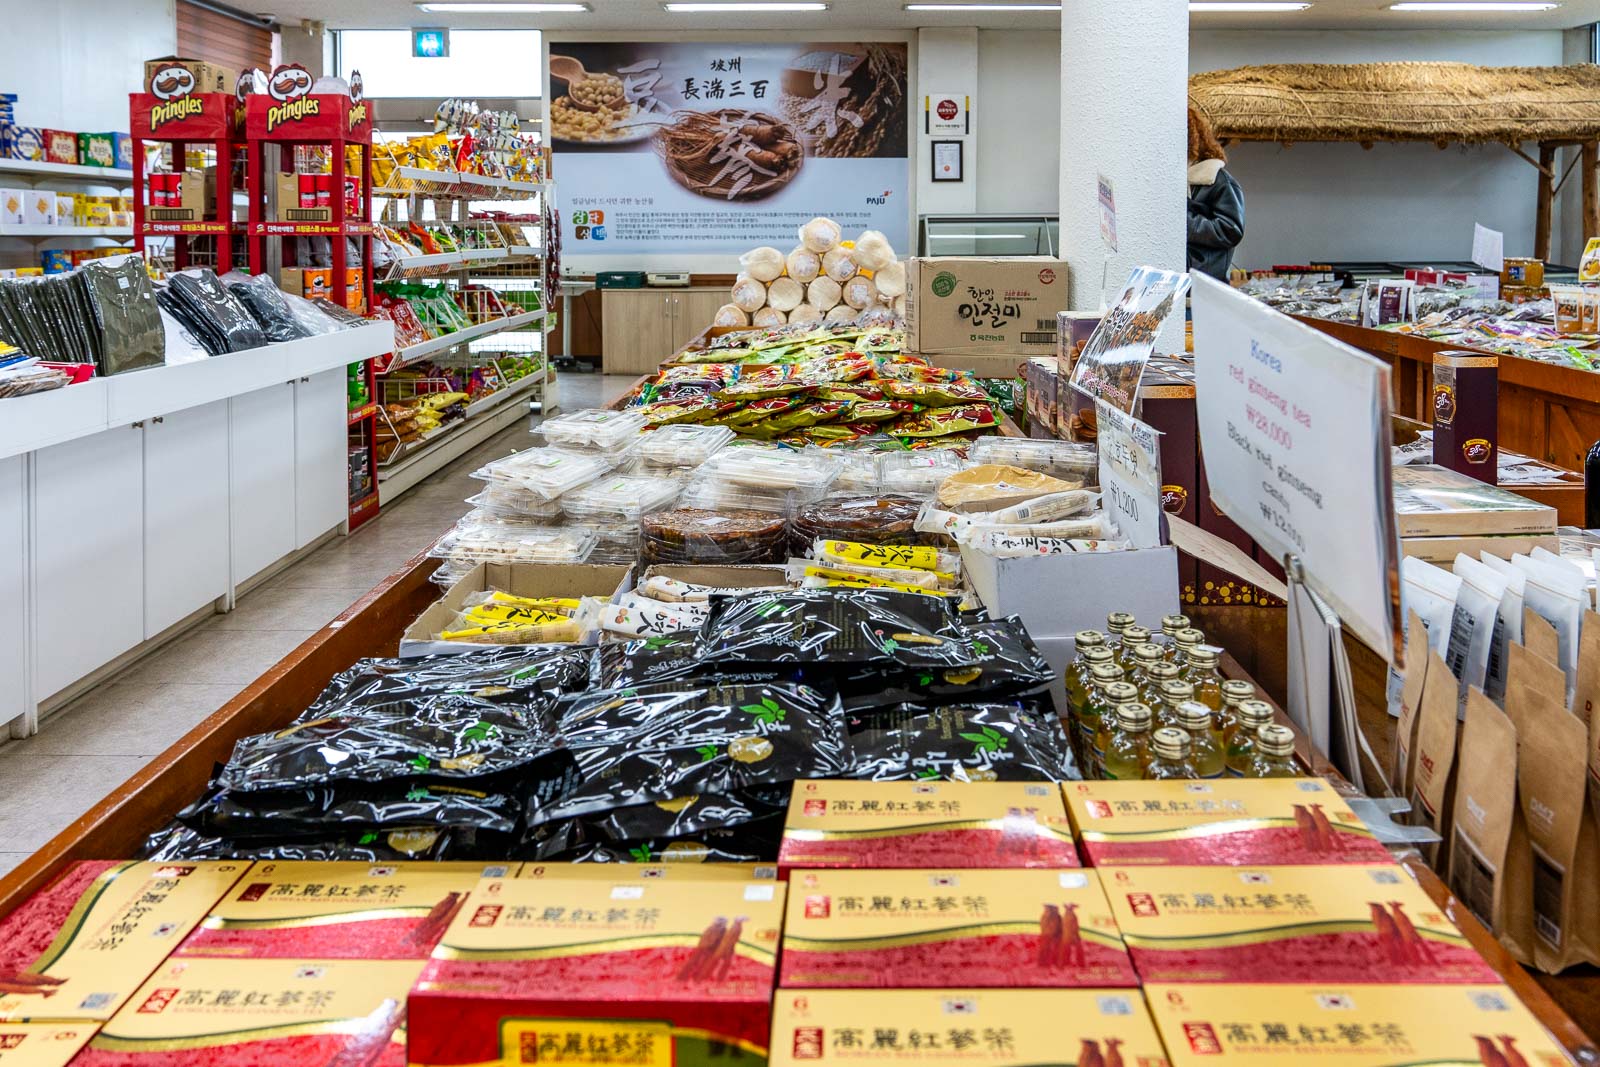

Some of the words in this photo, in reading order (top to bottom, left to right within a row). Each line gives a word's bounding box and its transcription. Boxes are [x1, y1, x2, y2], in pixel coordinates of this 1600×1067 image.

[710, 56, 742, 74] 坡州
[151, 96, 203, 132] Pringles
[267, 96, 319, 133] Pringles
[866, 197, 886, 206] PAJU
[967, 286, 995, 302] 한입
[958, 303, 1021, 329] 인절미
[1250, 339, 1283, 374] Korea
[1248, 376, 1288, 417] ginseng
[1292, 404, 1312, 429] tea
[1226, 420, 1252, 456] Black
[1277, 464, 1324, 510] ginseng
[262, 864, 277, 873] 6
[533, 866, 545, 876] 6
[488, 881, 502, 893] 6
